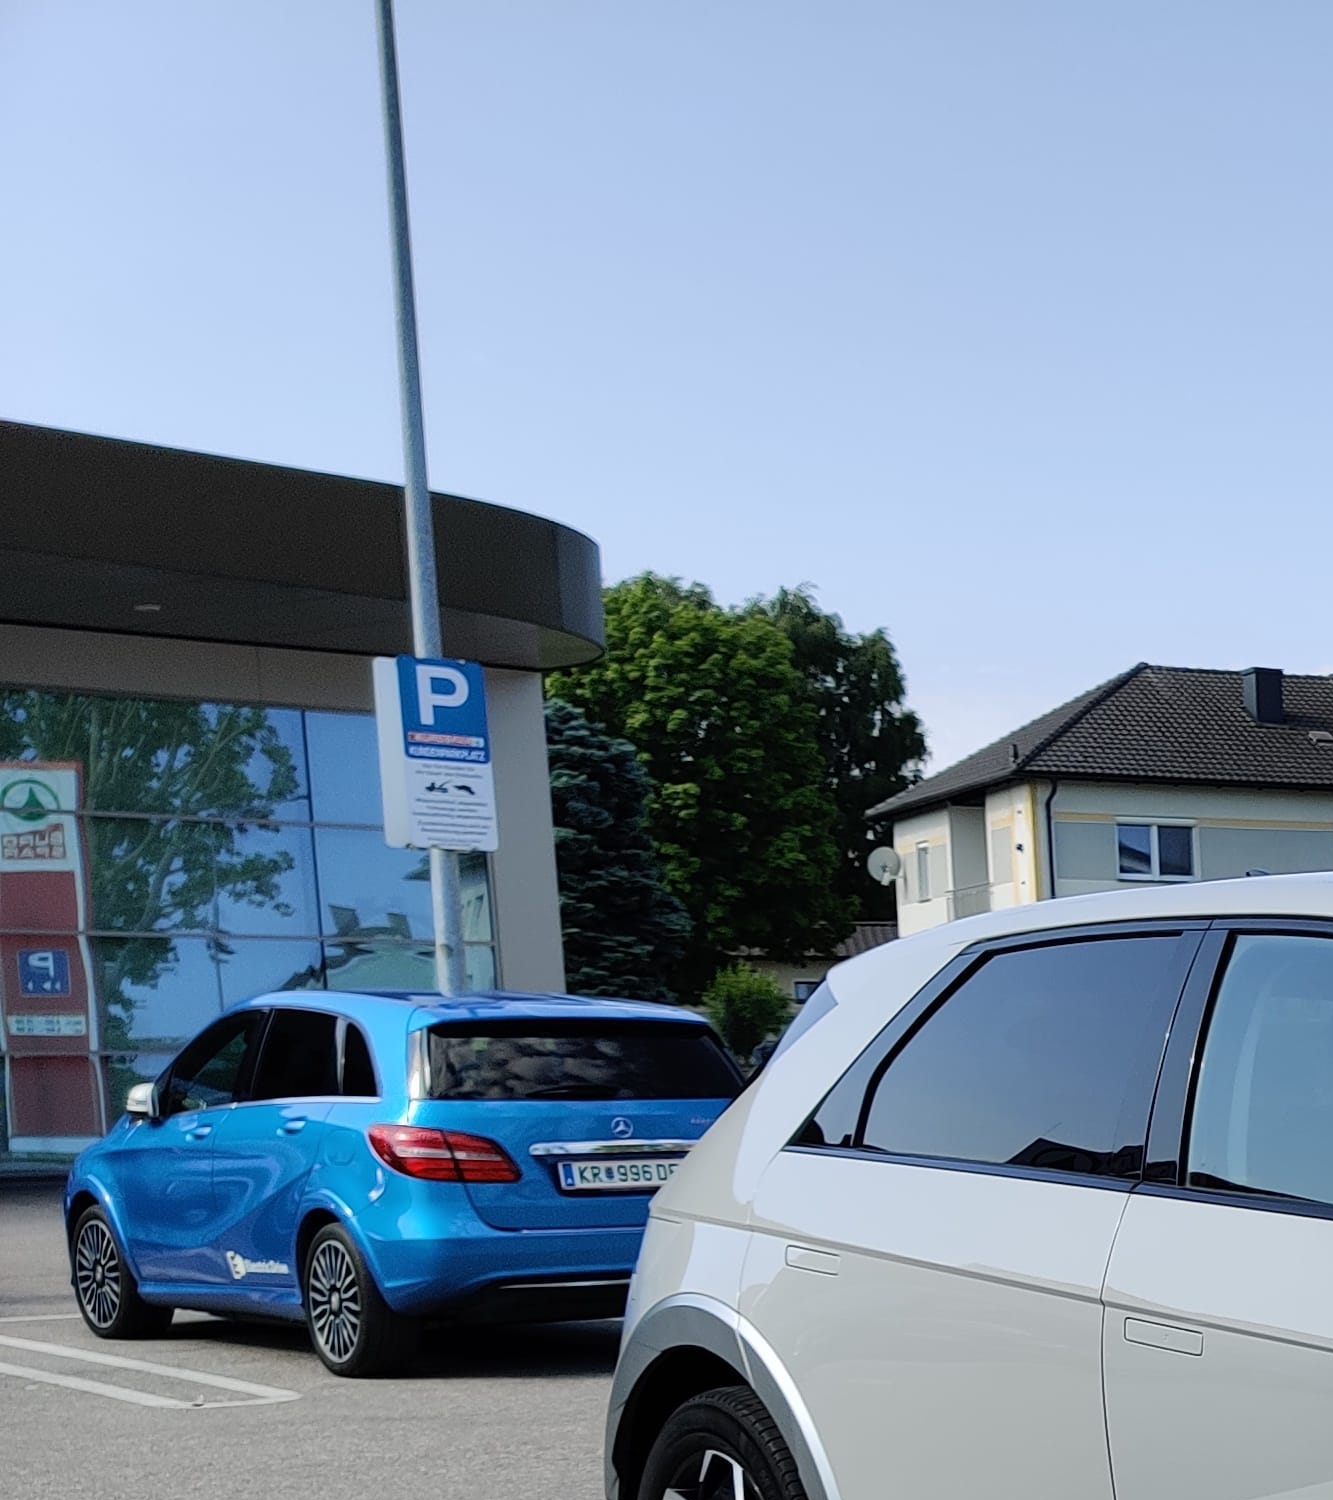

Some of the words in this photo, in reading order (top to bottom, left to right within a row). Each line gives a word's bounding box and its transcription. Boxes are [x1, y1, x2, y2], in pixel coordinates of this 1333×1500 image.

[416, 664, 469, 725] P
[577, 1166, 603, 1184] KR
[617, 1164, 653, 1182] 996
